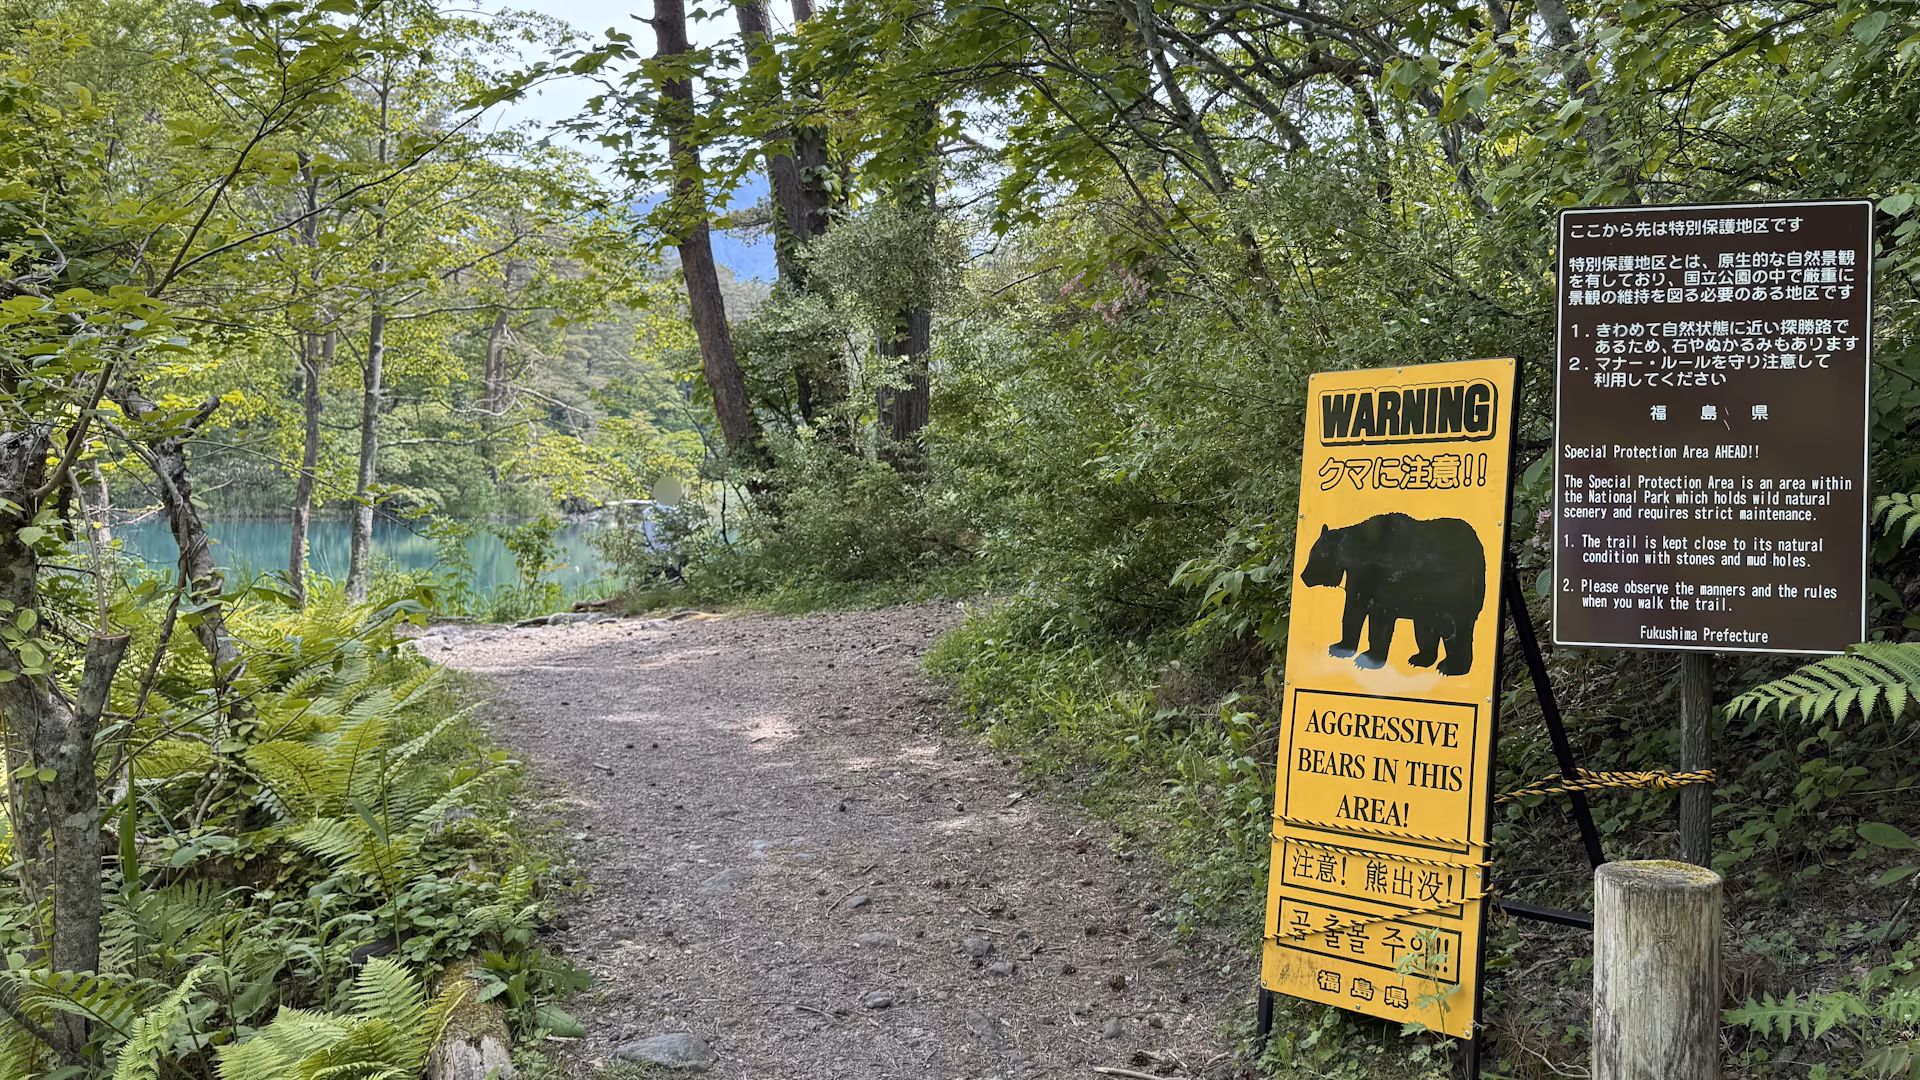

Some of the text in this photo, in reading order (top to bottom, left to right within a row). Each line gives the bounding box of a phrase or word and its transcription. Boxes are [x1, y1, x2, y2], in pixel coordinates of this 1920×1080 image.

[1570, 218, 1803, 238] ここから先は特別保護地区です
[1569, 250, 1855, 273] 特別保護地区とは、原生的な自然景観
[1569, 269, 1854, 288] を有しており、国立公園の中で厳重に
[1568, 286, 1854, 306] 景観の維持を図る必要のある地区です
[1596, 320, 1849, 338] きわめて自然状態に近い探勝路で
[1595, 336, 1859, 355] あるため、石やぬかるみもあります
[1596, 354, 1831, 370] マナー・ルールを守り注意して
[1594, 372, 1726, 388] 利用してください
[1322, 383, 1490, 438] WARNING
[1564, 445, 1760, 459] Special Protection Area AHEAD!!
[1319, 453, 1487, 491] クマに注意!!
[1564, 475, 1851, 490] The Special Protection Area is an area within
[1564, 491, 1830, 505] the National Park which holds wild natural
[1564, 506, 1817, 521] scenery and requires strict maintenance.
[1582, 535, 1600, 548] The
[1607, 535, 1637, 549] trail
[1645, 536, 1657, 549] is
[1663, 536, 1688, 550] kept
[1694, 537, 1726, 550] close
[1733, 539, 1747, 550] to
[1753, 538, 1772, 551] its
[1778, 538, 1823, 552] natural
[1583, 552, 1811, 567] condition with stones and mud holes.
[1581, 580, 1619, 593] Please
[1625, 582, 1668, 594] observe
[1675, 582, 1694, 595] the
[1700, 585, 1745, 596] manners
[1752, 584, 1771, 597] and
[1778, 585, 1797, 598] the
[1804, 585, 1837, 599] rules
[1582, 595, 1732, 611] when you walk the trail.
[1641, 626, 1768, 643] Fukushima Prefecture
[1305, 709, 1458, 748] AGGRESSIVE
[1297, 748, 1462, 792] BEARS IN THIS
[1336, 794, 1409, 828] AREA!
[1290, 910, 1310, 941] 곰
[1325, 914, 1370, 954] 출몰
